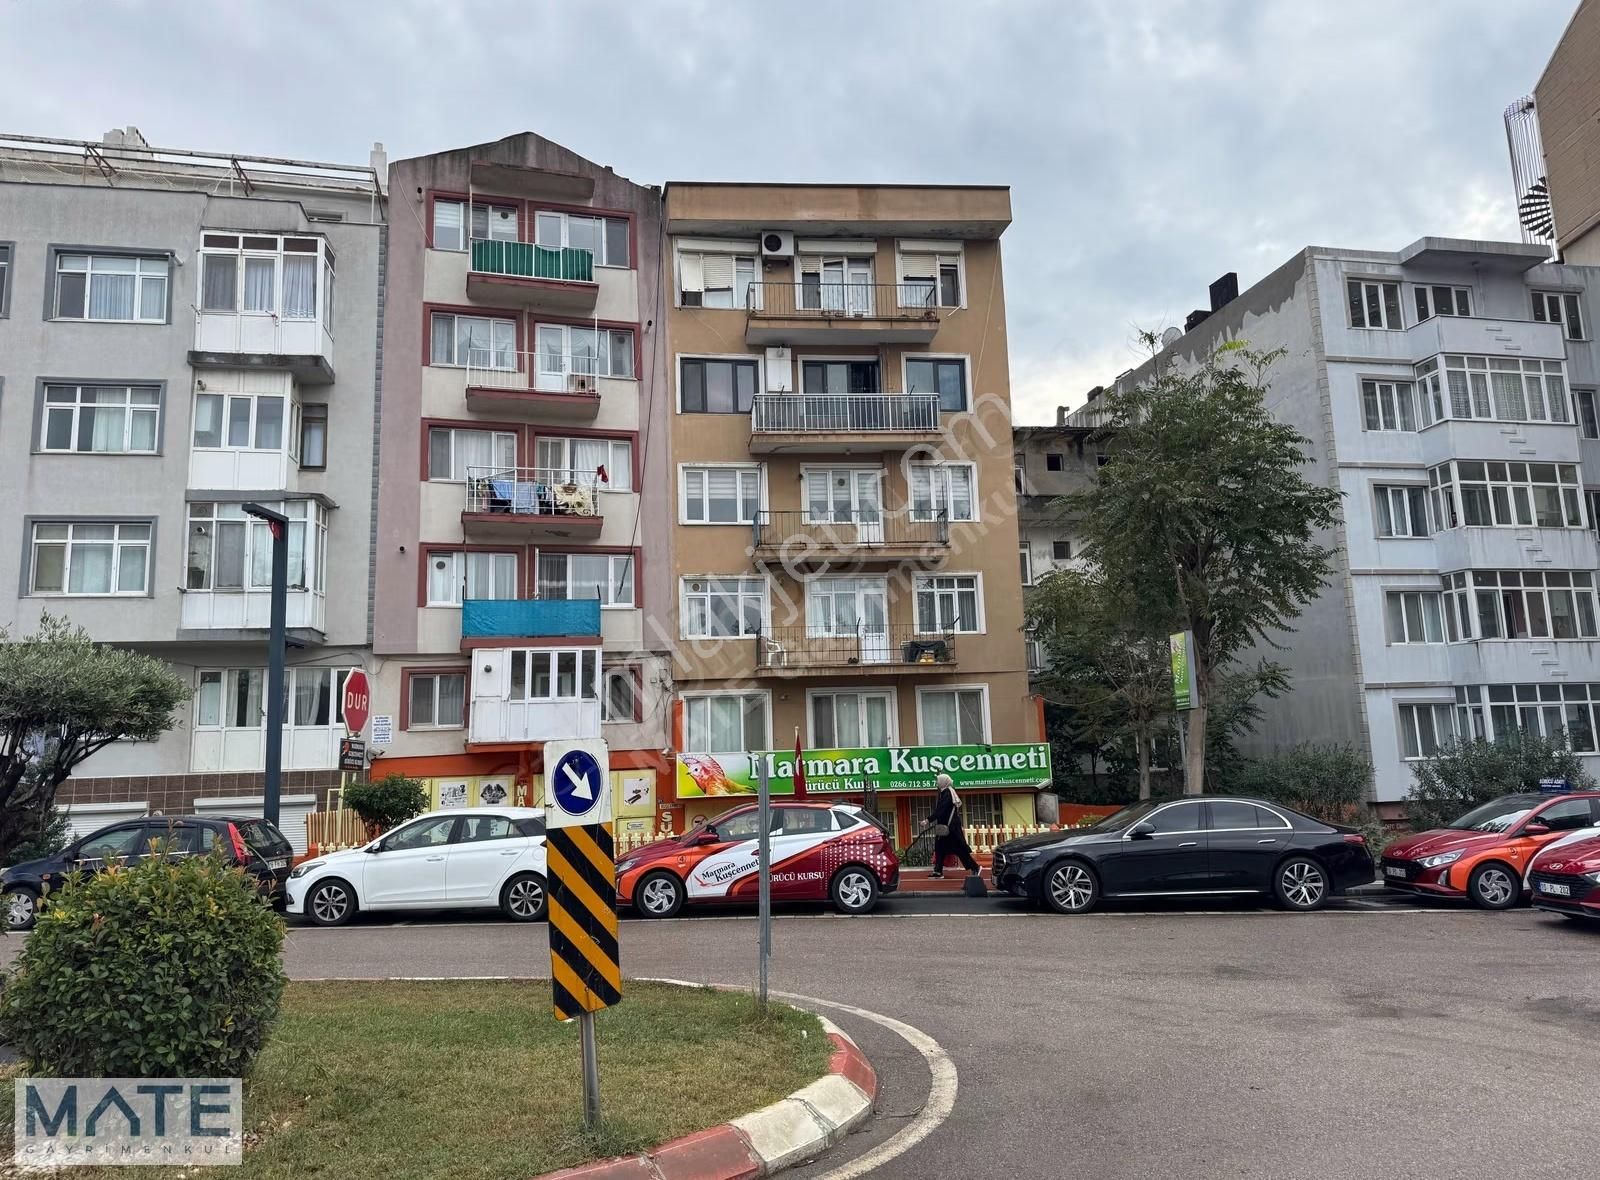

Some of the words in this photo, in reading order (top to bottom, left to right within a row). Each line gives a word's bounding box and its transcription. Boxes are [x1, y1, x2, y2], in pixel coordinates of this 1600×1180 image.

[347, 691, 368, 711] DUR
[805, 779, 840, 791] ürücü
[702, 863, 736, 879] Marmara
[715, 858, 759, 882] Kuşcennet
[797, 871, 825, 881] KURSU
